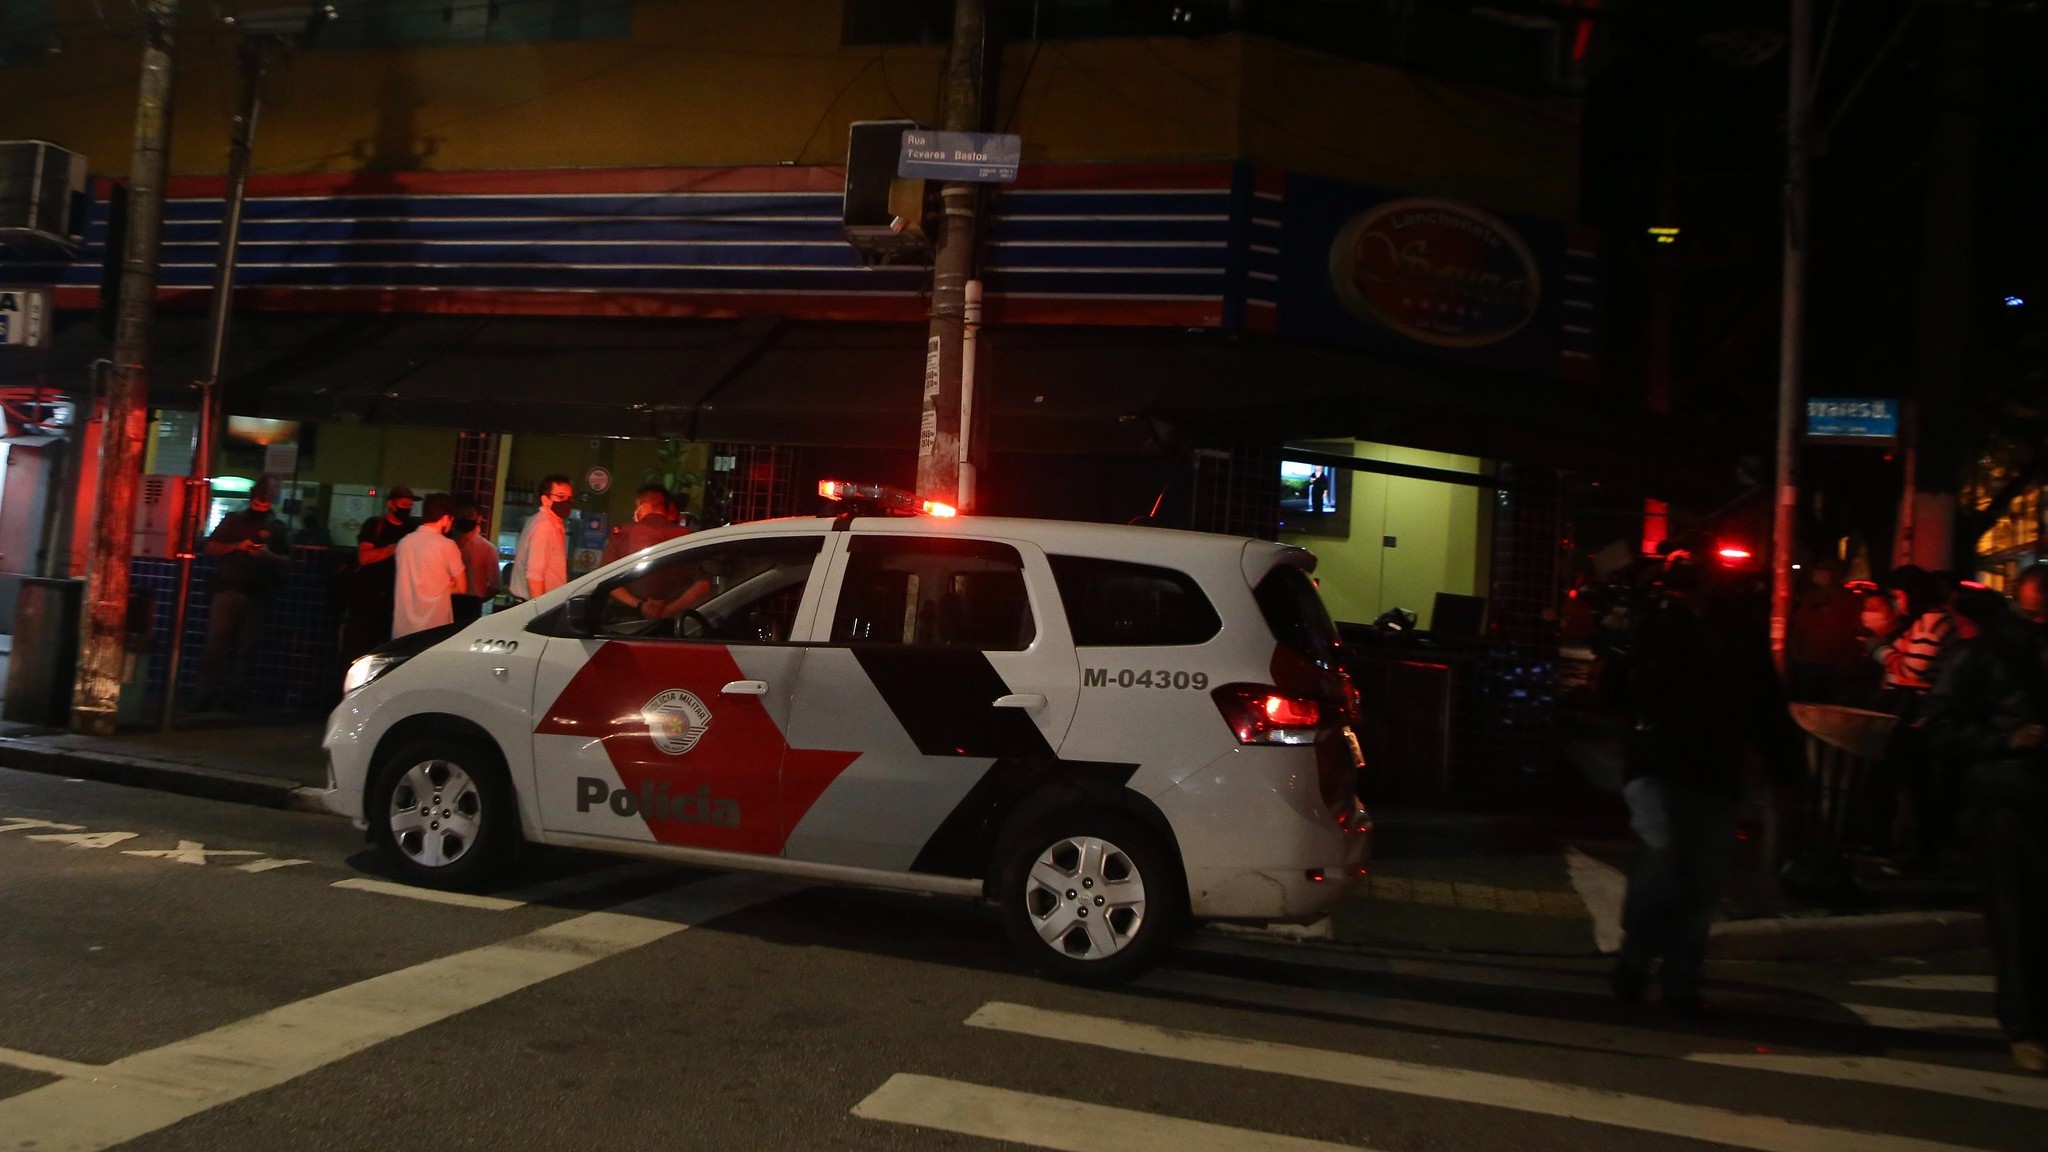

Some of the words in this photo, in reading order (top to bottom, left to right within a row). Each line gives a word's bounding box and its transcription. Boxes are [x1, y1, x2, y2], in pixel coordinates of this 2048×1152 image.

[907, 134, 926, 146] Rua
[907, 149, 946, 159] Tavares
[954, 151, 988, 161] Bastos
[1083, 667, 1209, 691] M-04309
[679, 693, 706, 720] MILITAR
[576, 776, 741, 828] Polícia
